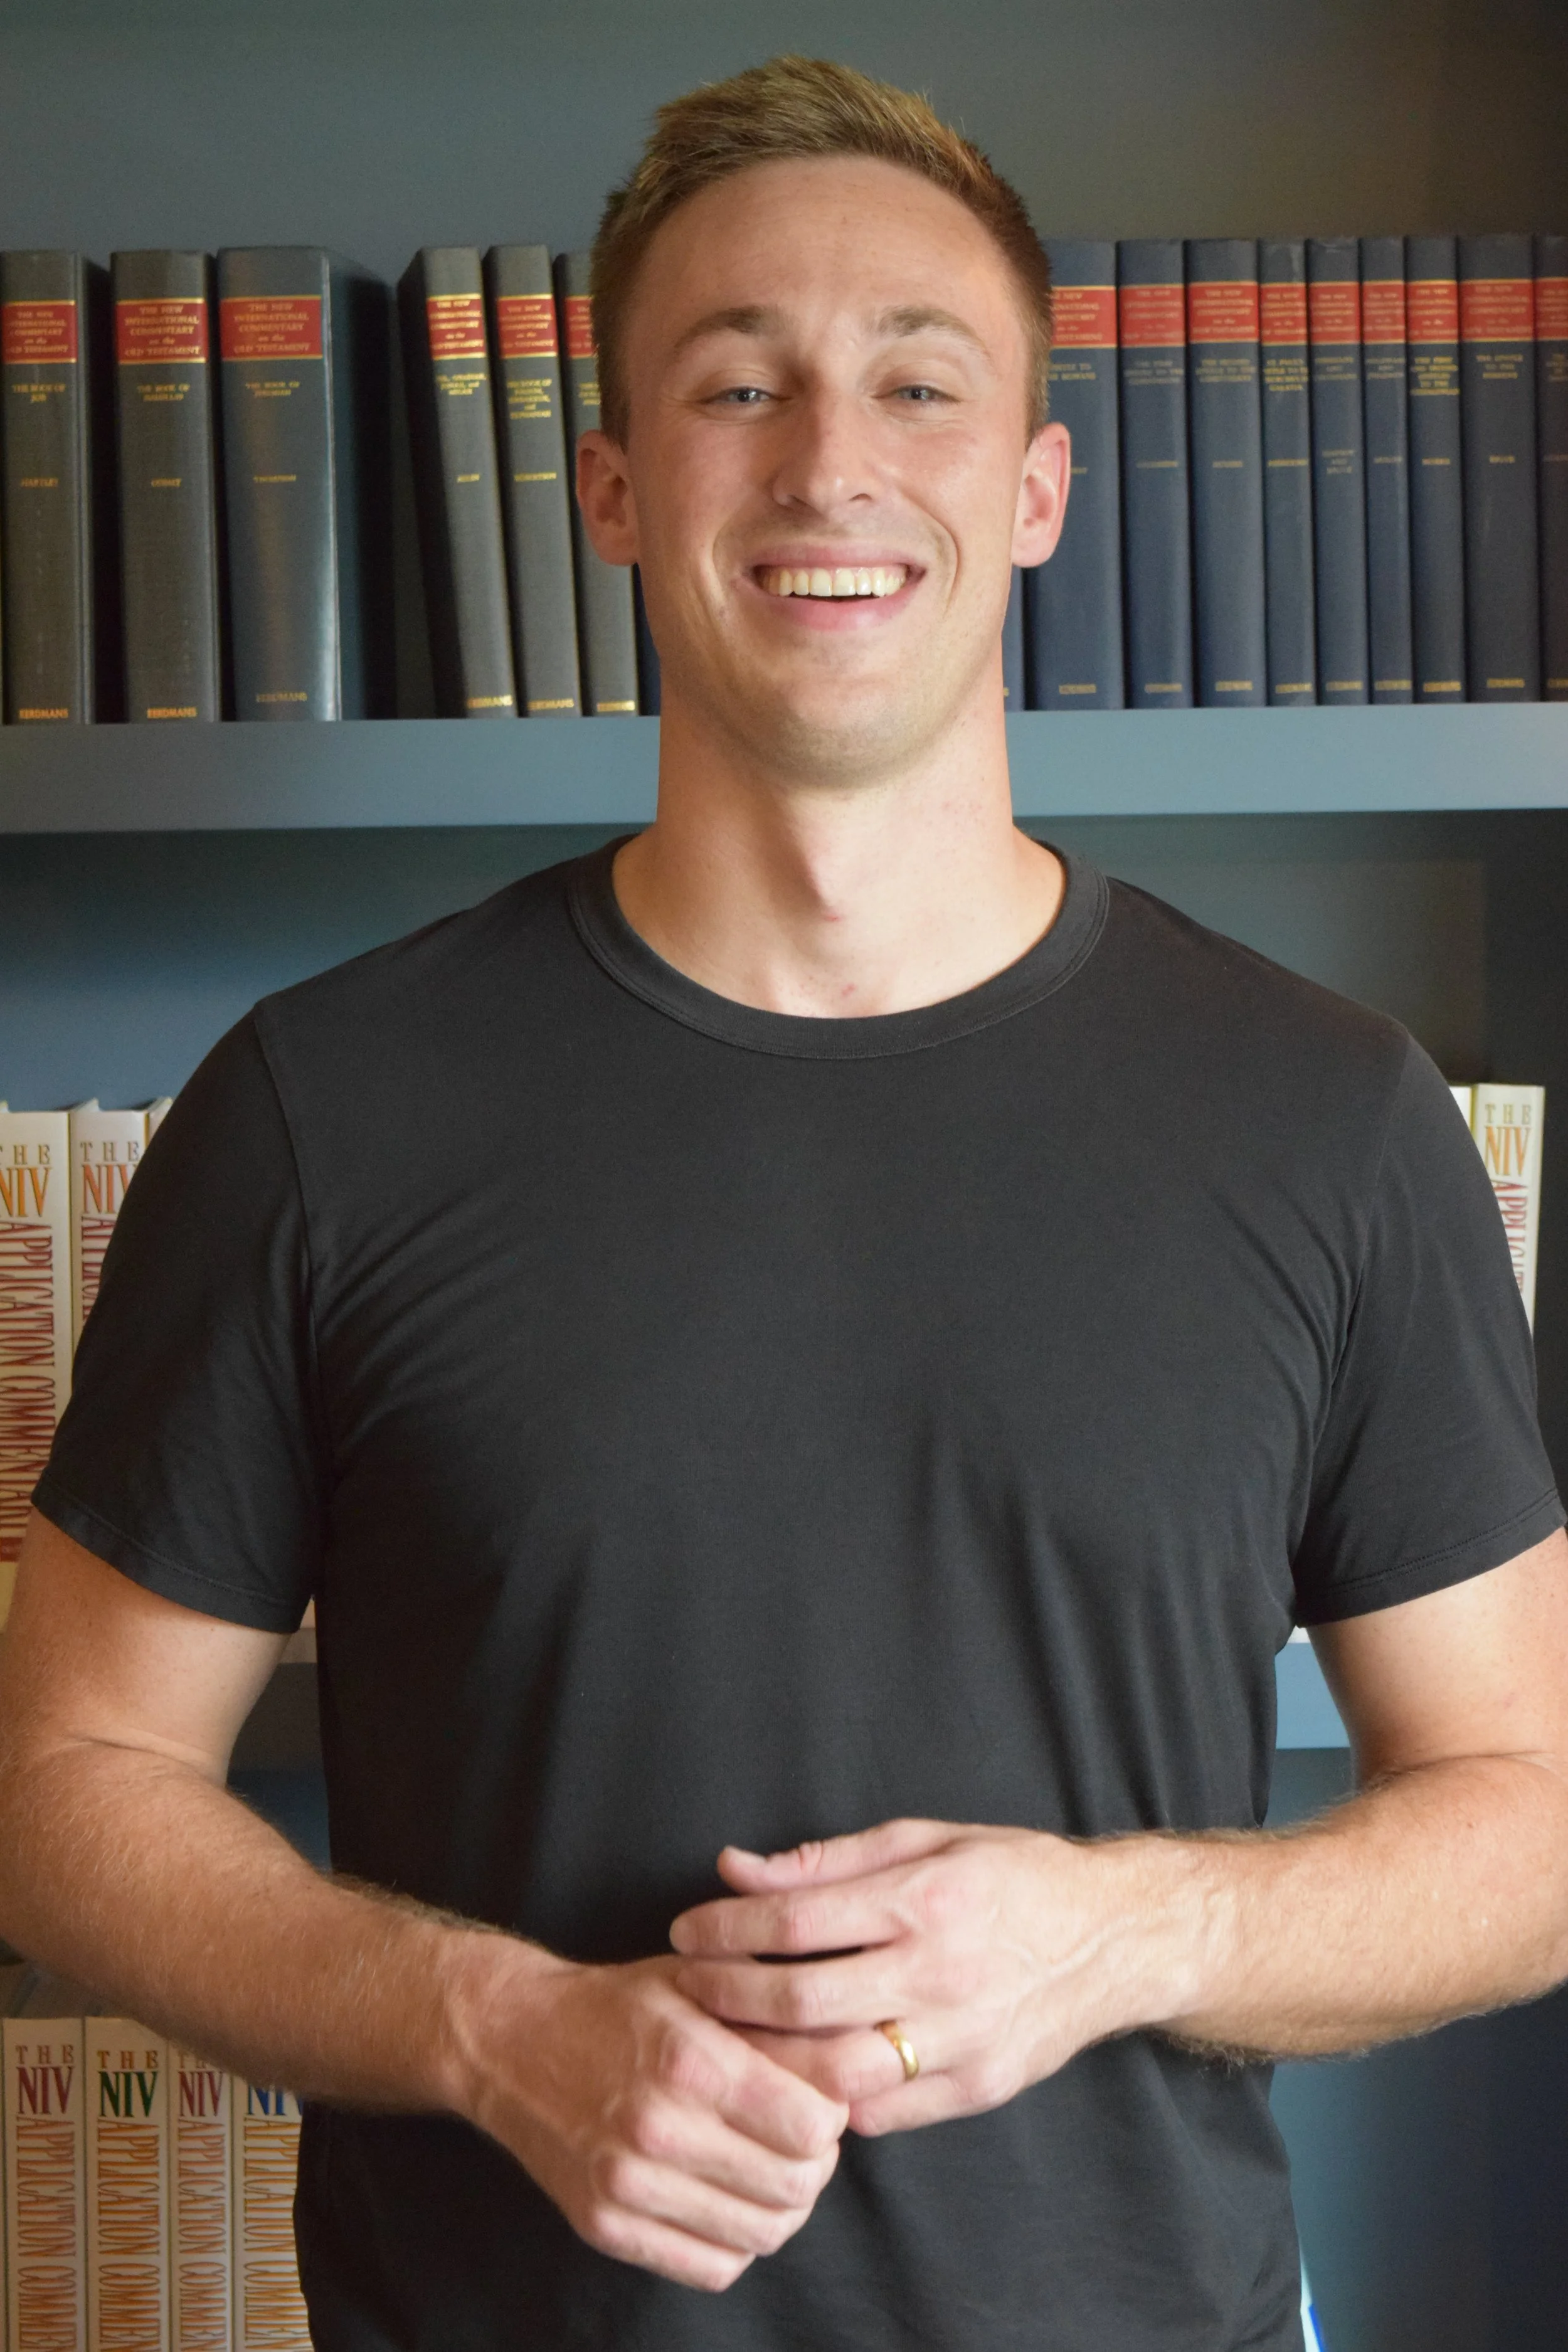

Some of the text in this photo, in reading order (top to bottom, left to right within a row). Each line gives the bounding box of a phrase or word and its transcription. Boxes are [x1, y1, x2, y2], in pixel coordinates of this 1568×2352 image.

[161, 305, 184, 314] NEW
[233, 312, 309, 322] INTERNATIONAL
[248, 302, 294, 311] THE NEW
[124, 315, 199, 326] INTERNATIONAL
[130, 326, 194, 336] COMMENTARY
[239, 322, 305, 332] COMMENTARY
[146, 346, 200, 356] TESTAMENT
[255, 342, 312, 352] TESTAMENT
[1485, 1104, 1532, 1125] THE
[0, 1144, 51, 1165] HE
[80, 1141, 139, 1162] THE
[1484, 1126, 1530, 1177] NIV
[0, 1167, 53, 1217] NIV
[0, 1220, 55, 1367] APPLICATION
[16, 2045, 74, 2065] THE
[97, 2050, 158, 2069] THE
[17, 2066, 74, 2115] NIV
[98, 2071, 158, 2117] NIV
[178, 2071, 225, 2117] NIV
[16, 2116, 75, 2257] APPLICATION
[97, 2119, 160, 2256] APPLICATION
[178, 2119, 226, 2255] APPLICATION
